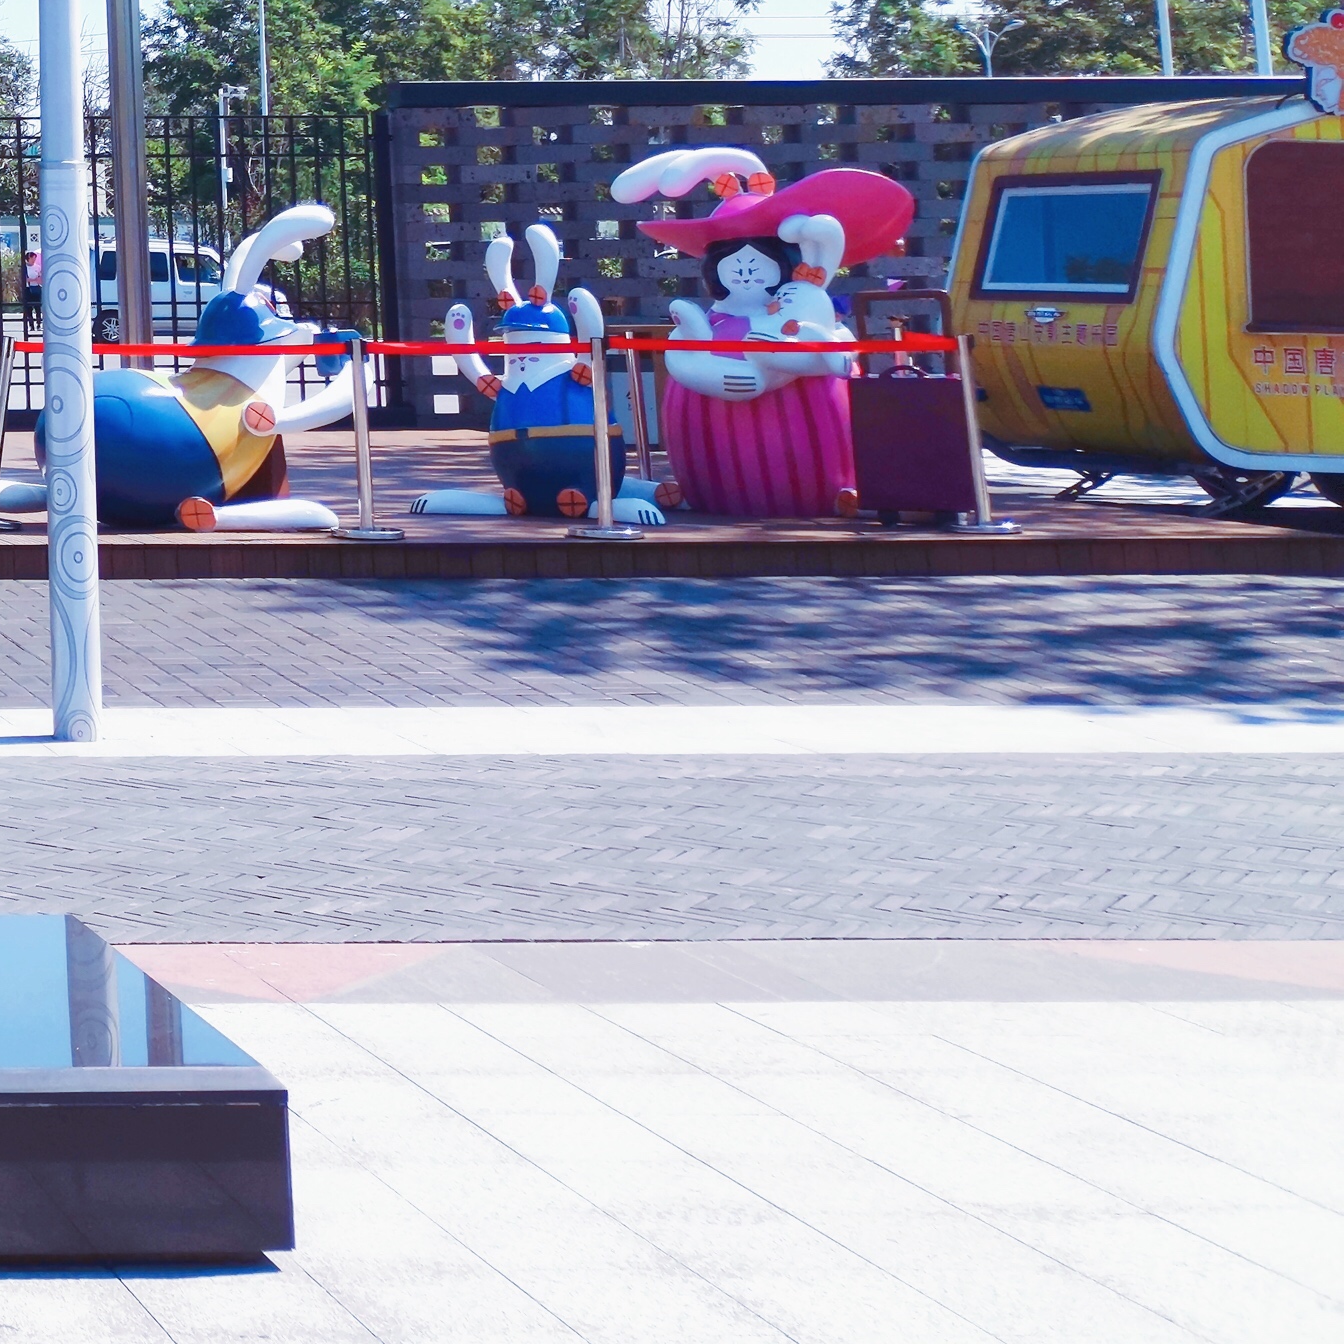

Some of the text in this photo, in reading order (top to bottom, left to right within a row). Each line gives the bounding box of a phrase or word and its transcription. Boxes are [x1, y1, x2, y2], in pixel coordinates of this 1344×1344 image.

[1253, 346, 1336, 375] 中国唐
[1255, 383, 1309, 395] SHADOW
